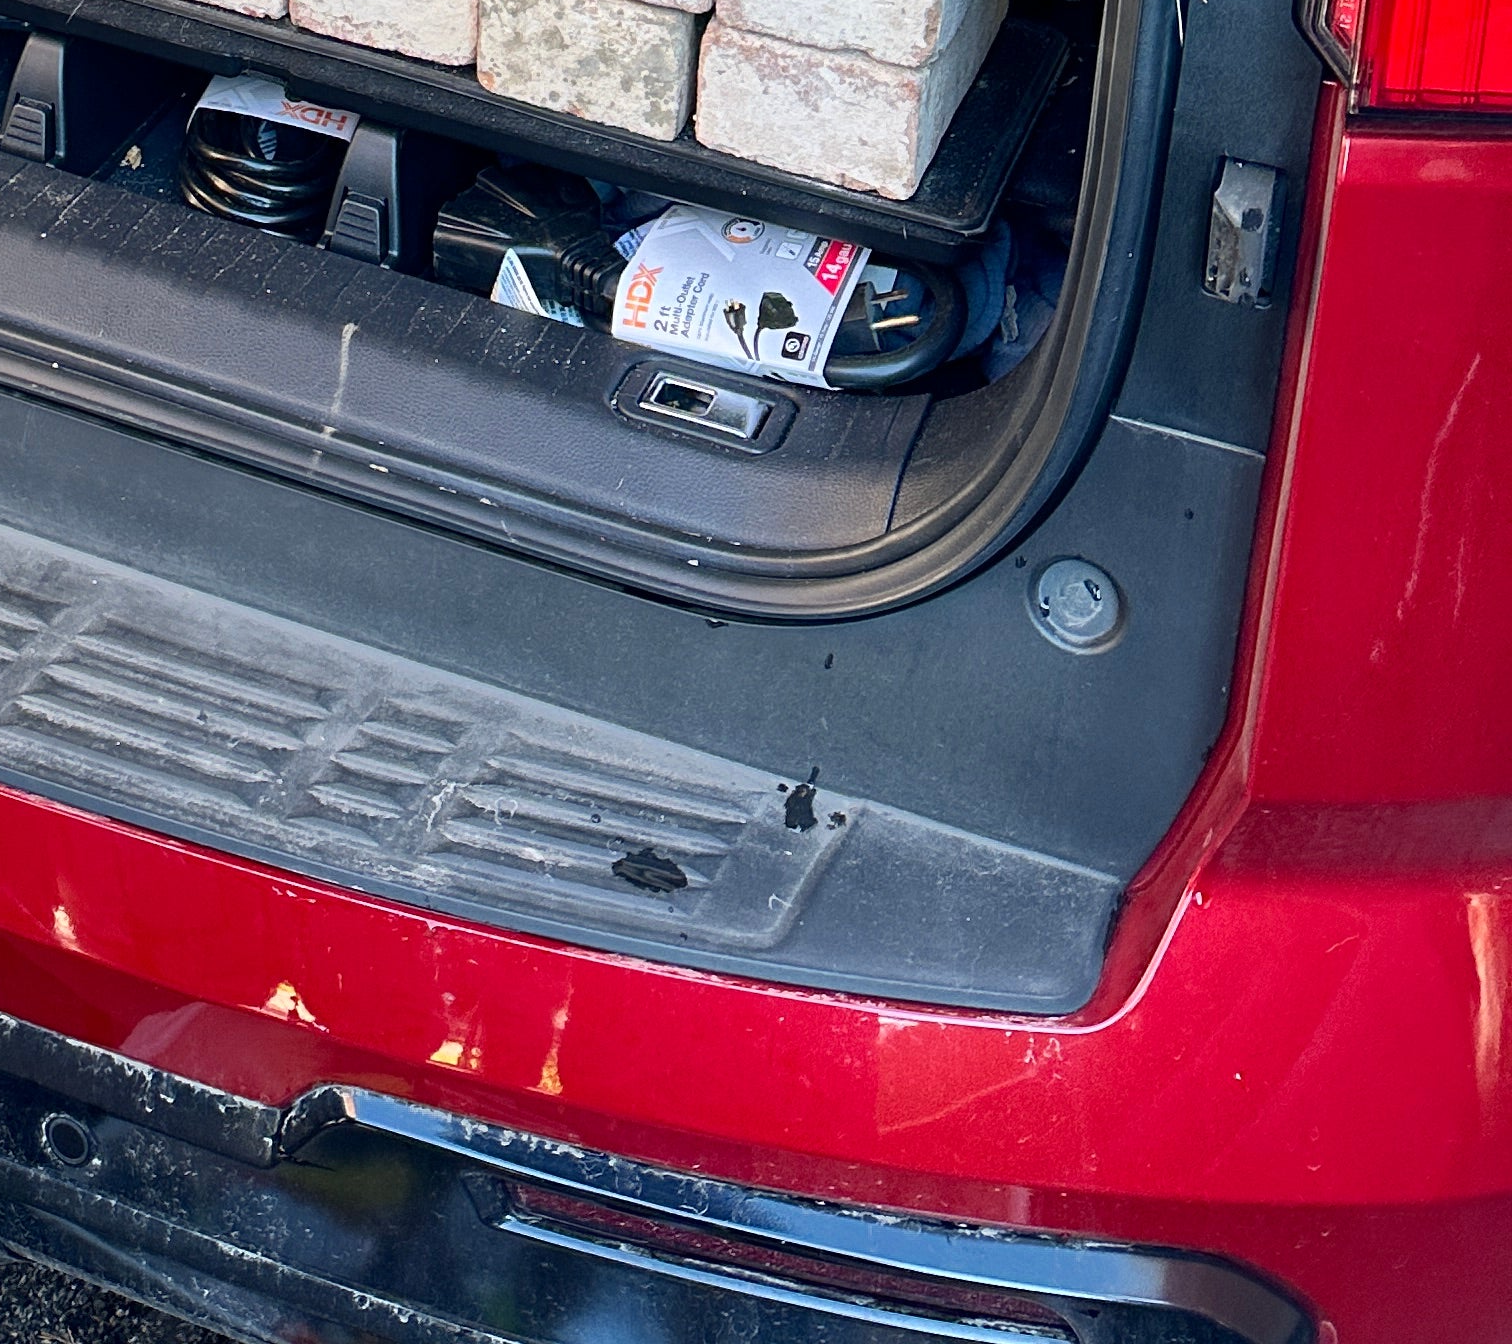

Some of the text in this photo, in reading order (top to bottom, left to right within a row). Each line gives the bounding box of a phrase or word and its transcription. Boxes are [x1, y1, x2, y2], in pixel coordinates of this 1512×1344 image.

[275, 100, 348, 131] HDX
[806, 256, 819, 268] 15
[821, 262, 839, 282] 14
[622, 263, 664, 329] HDX
[669, 276, 695, 336] Multi-Outlet
[680, 272, 710, 338] Adapter Cord
[654, 304, 672, 332] 2 ft
